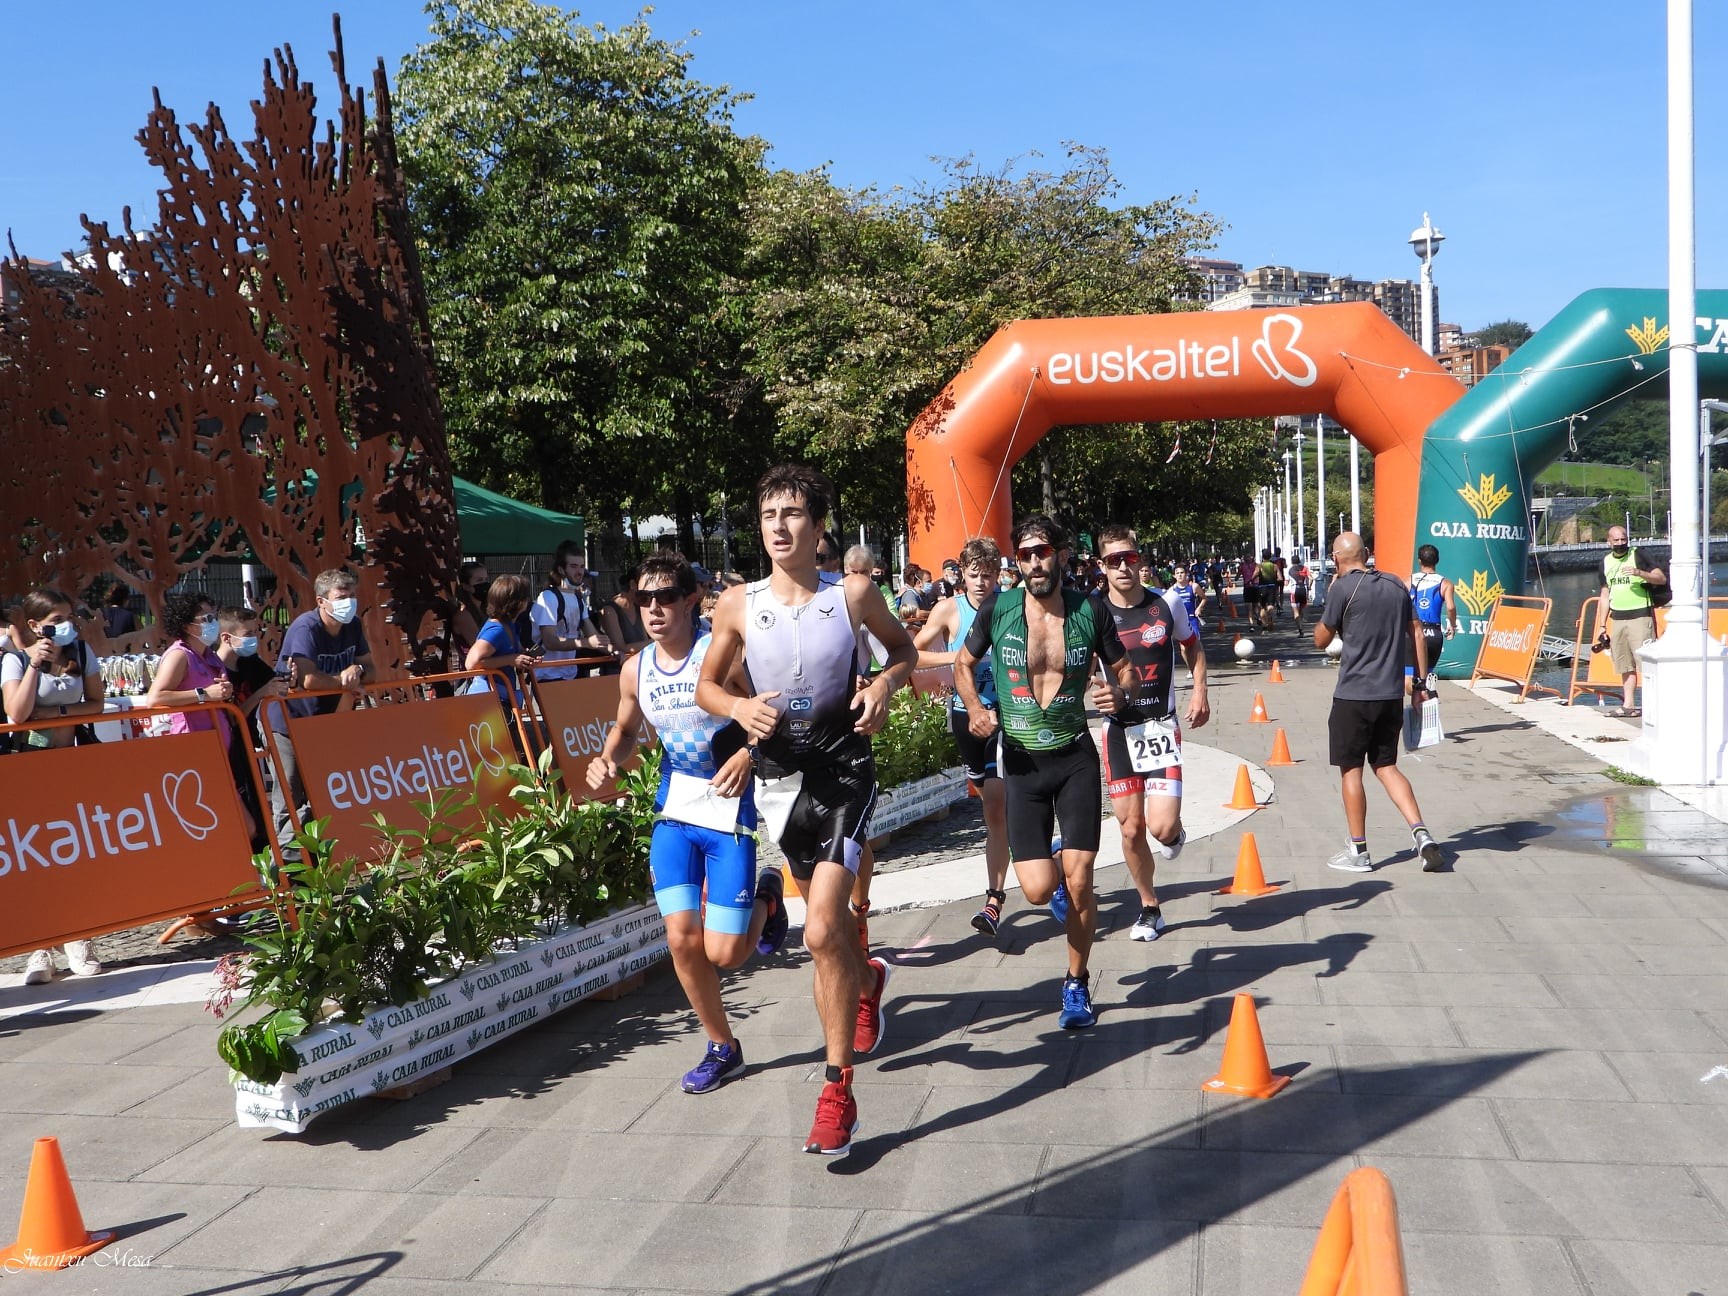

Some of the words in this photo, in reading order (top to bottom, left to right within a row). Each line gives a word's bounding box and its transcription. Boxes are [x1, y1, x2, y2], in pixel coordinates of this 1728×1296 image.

[1048, 336, 1239, 384] euskaltel
[1430, 522, 1472, 538] CAJA
[1476, 523, 1526, 540] RURAL
[1134, 735, 1174, 761] 252
[327, 739, 475, 809] euskaltel
[577, 933, 605, 953] RURAL
[476, 972, 501, 991] CAJA
[500, 960, 533, 982] RURAL
[535, 972, 564, 994] RURAL
[583, 973, 610, 994] RURAL
[387, 1010, 415, 1028] CAJA
[416, 993, 452, 1018] RURAL
[452, 1006, 486, 1031] RURAL
[507, 1005, 539, 1029] RURAL
[311, 1032, 357, 1064] RURAL
[420, 1043, 456, 1071] RURAL
